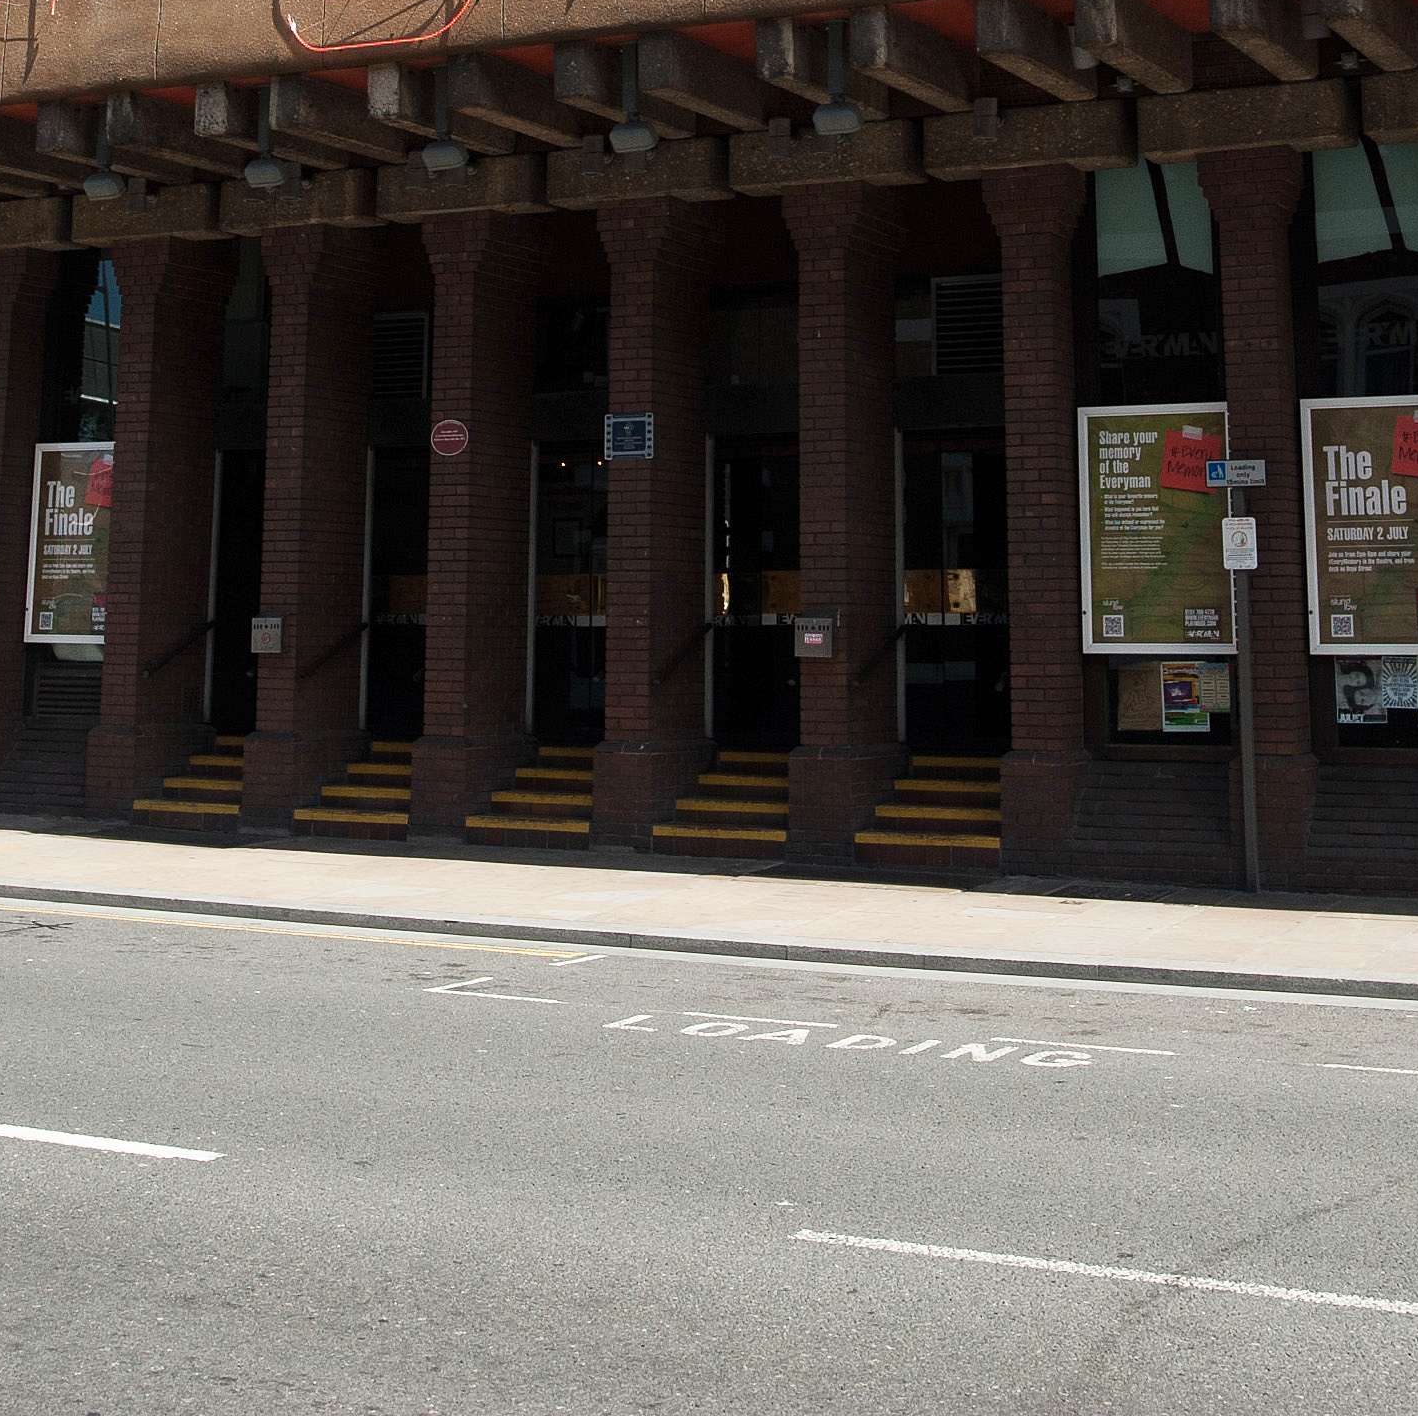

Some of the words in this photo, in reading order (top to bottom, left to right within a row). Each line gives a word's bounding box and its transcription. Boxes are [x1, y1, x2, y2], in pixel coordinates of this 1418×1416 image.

[1099, 430, 1130, 445] Share
[1133, 431, 1158, 446] your
[1099, 446, 1141, 461] memory
[1100, 460, 1109, 474] of
[1113, 460, 1129, 474] the
[1231, 464, 1255, 472] Loading
[1323, 445, 1373, 480] The
[1099, 474, 1151, 491] Everyman
[47, 480, 76, 508] The
[1325, 480, 1407, 516] Finale
[44, 507, 93, 536] Finale
[1327, 527, 1374, 541] SATURDAY
[1377, 526, 1385, 540] 2
[1386, 526, 1409, 540] JULY
[602, 1014, 1093, 1068] LOADING
